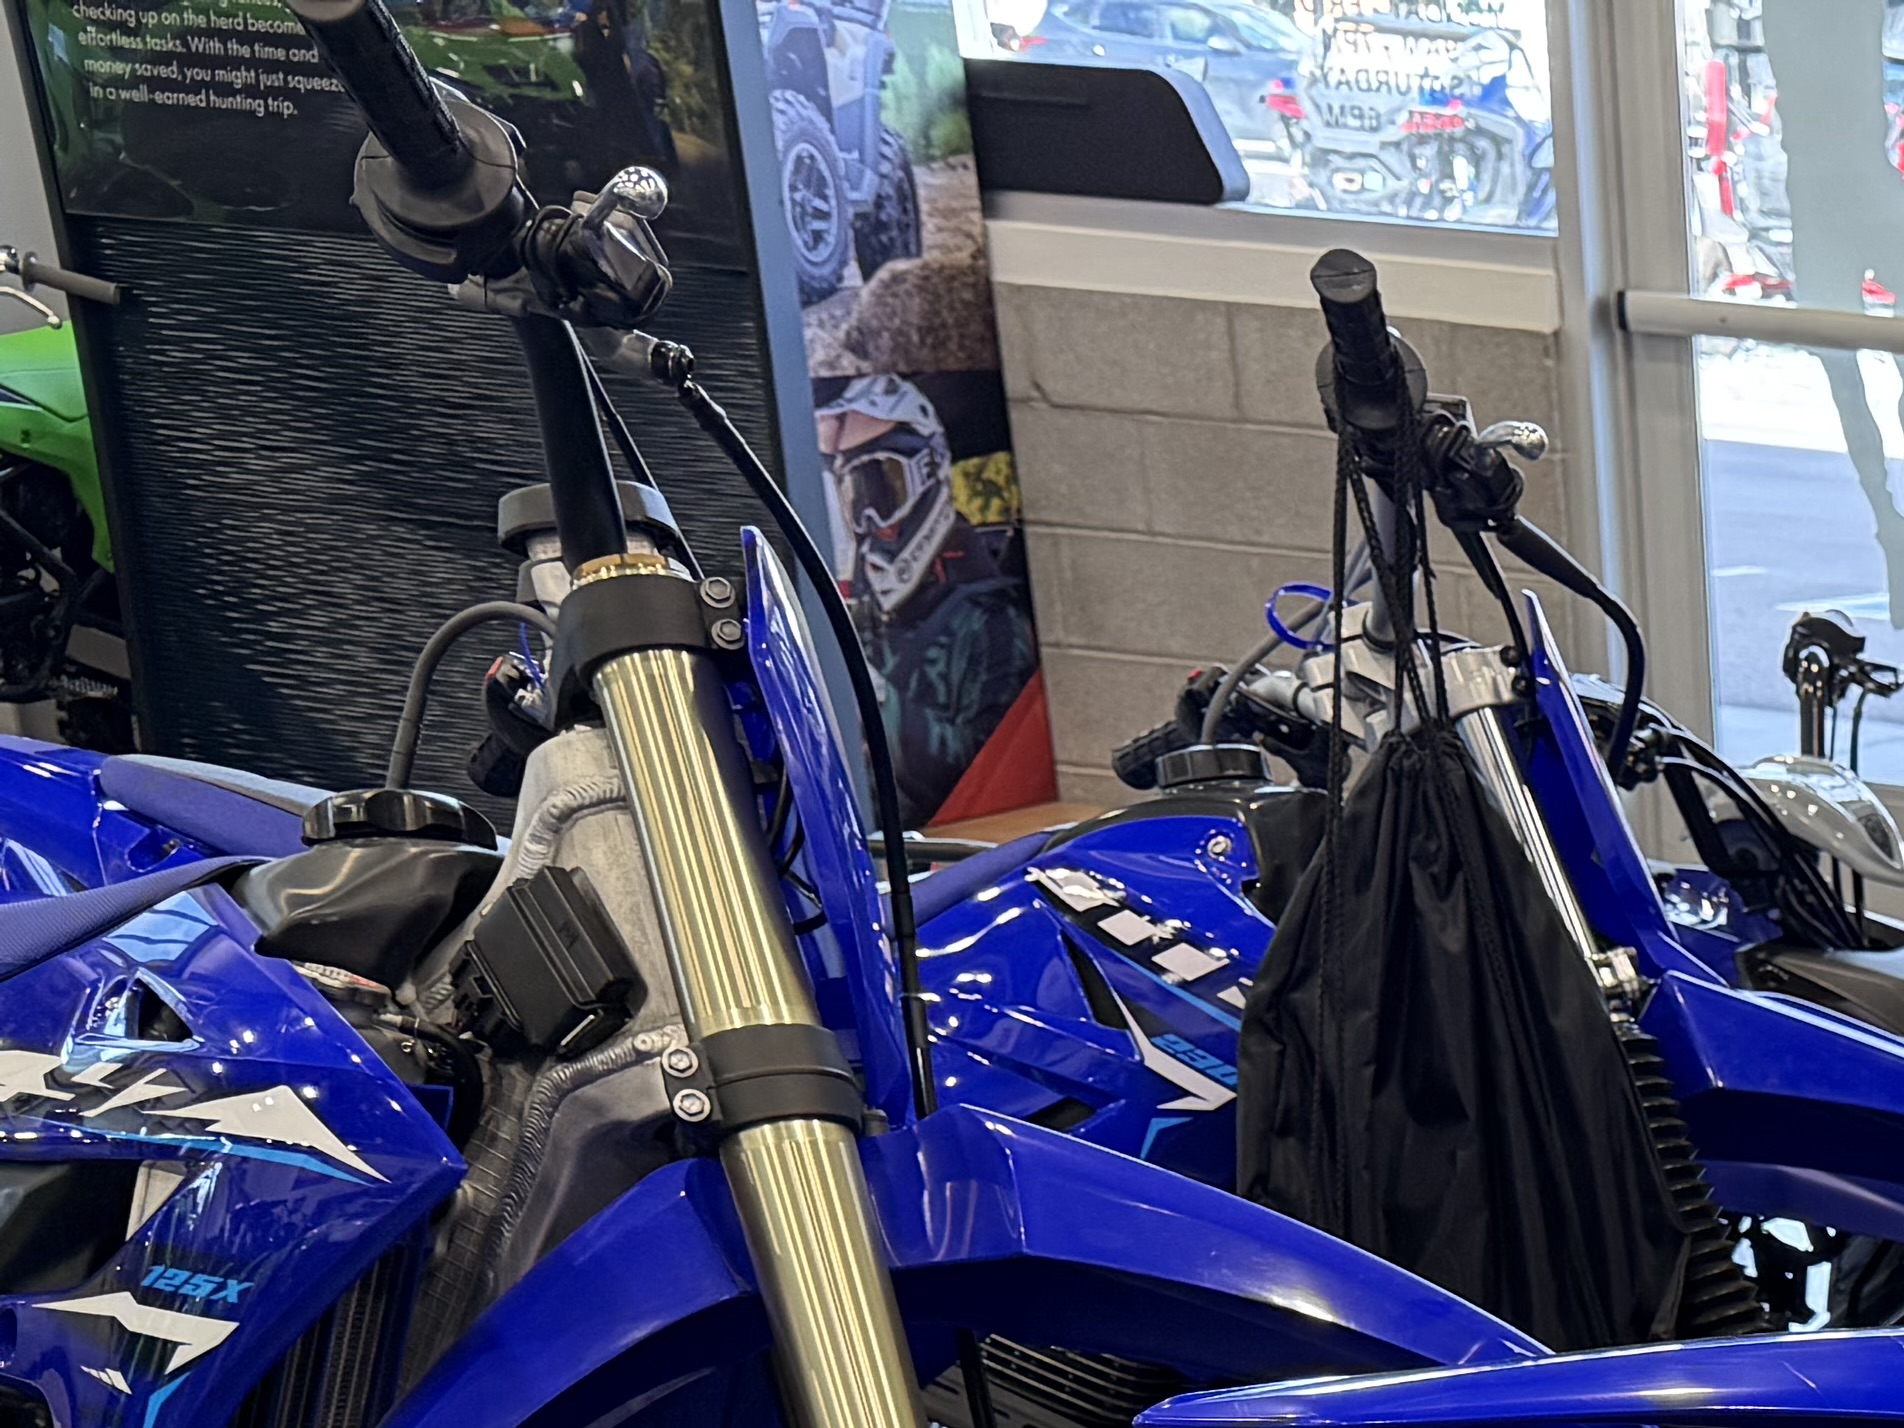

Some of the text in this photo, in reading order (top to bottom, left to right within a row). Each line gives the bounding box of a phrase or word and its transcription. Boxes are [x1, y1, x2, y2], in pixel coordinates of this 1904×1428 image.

[72, 3, 135, 28] checking
[139, 11, 158, 30] up
[161, 13, 180, 27] on
[183, 11, 206, 29] the
[210, 13, 243, 31] herd
[78, 25, 319, 63] effortless tasks. With the time and
[84, 57, 132, 80] money
[134, 59, 182, 82] saved,
[184, 66, 211, 84] you
[215, 64, 255, 89] might
[259, 69, 284, 90] just
[89, 82, 298, 120] in a well-earned hunting trip.
[141, 1263, 255, 1303] 125X
